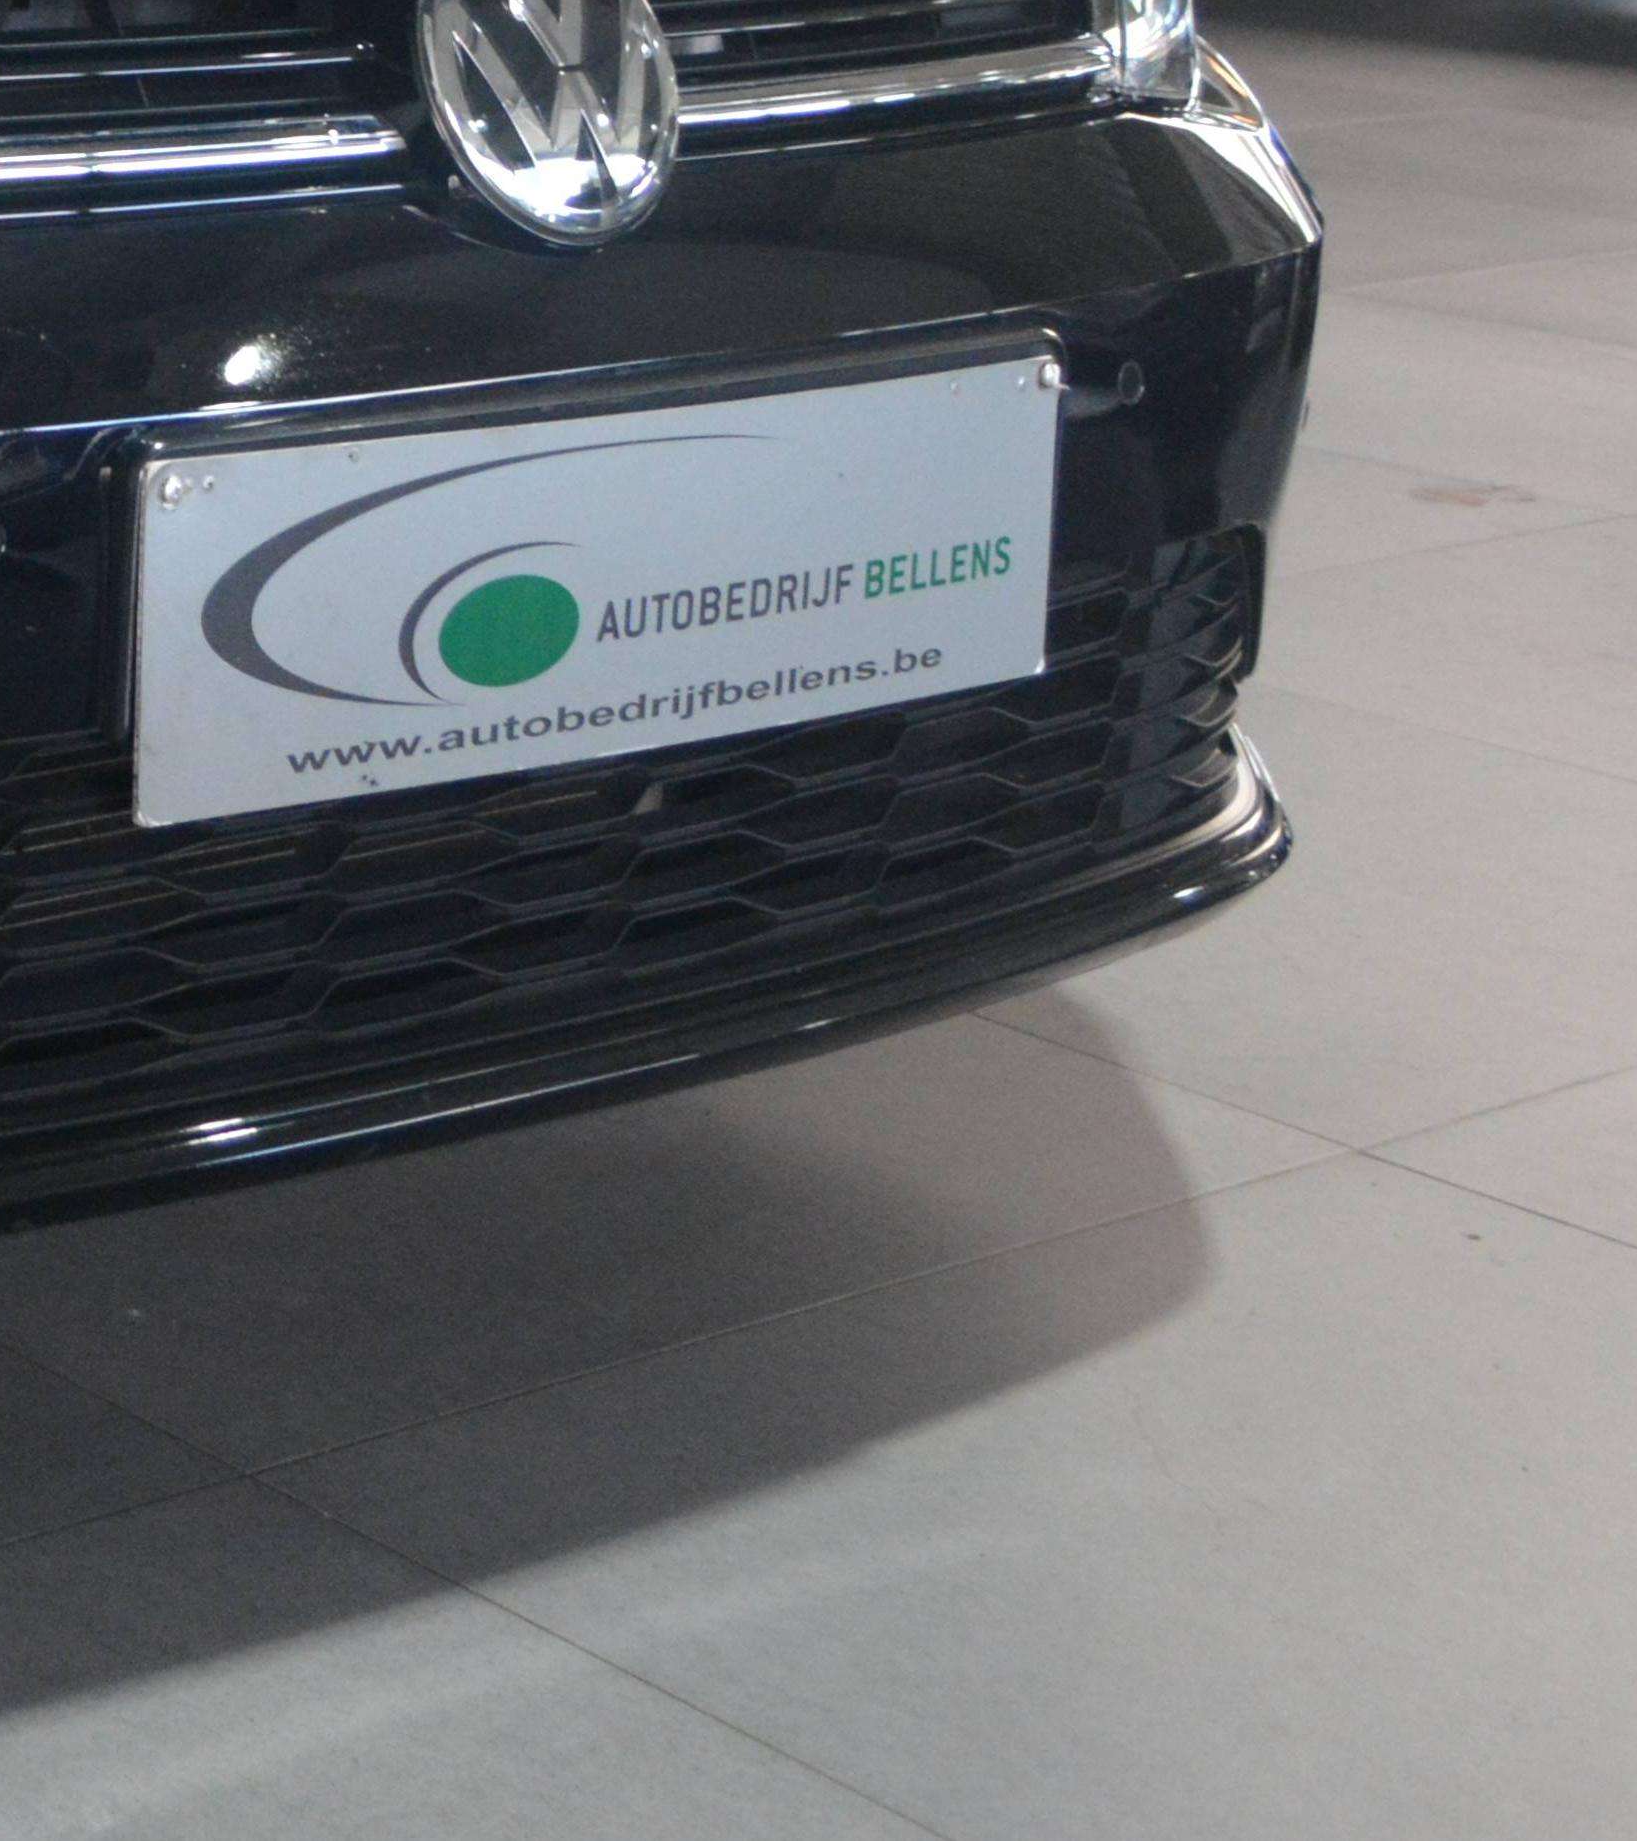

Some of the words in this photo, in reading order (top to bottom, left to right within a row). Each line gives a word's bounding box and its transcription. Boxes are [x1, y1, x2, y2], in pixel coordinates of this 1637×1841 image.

[597, 565, 854, 643] AUTOBEDRIJF
[863, 535, 1013, 599] BELLENS
[286, 643, 943, 775] www.autobedrijfbellens.be
